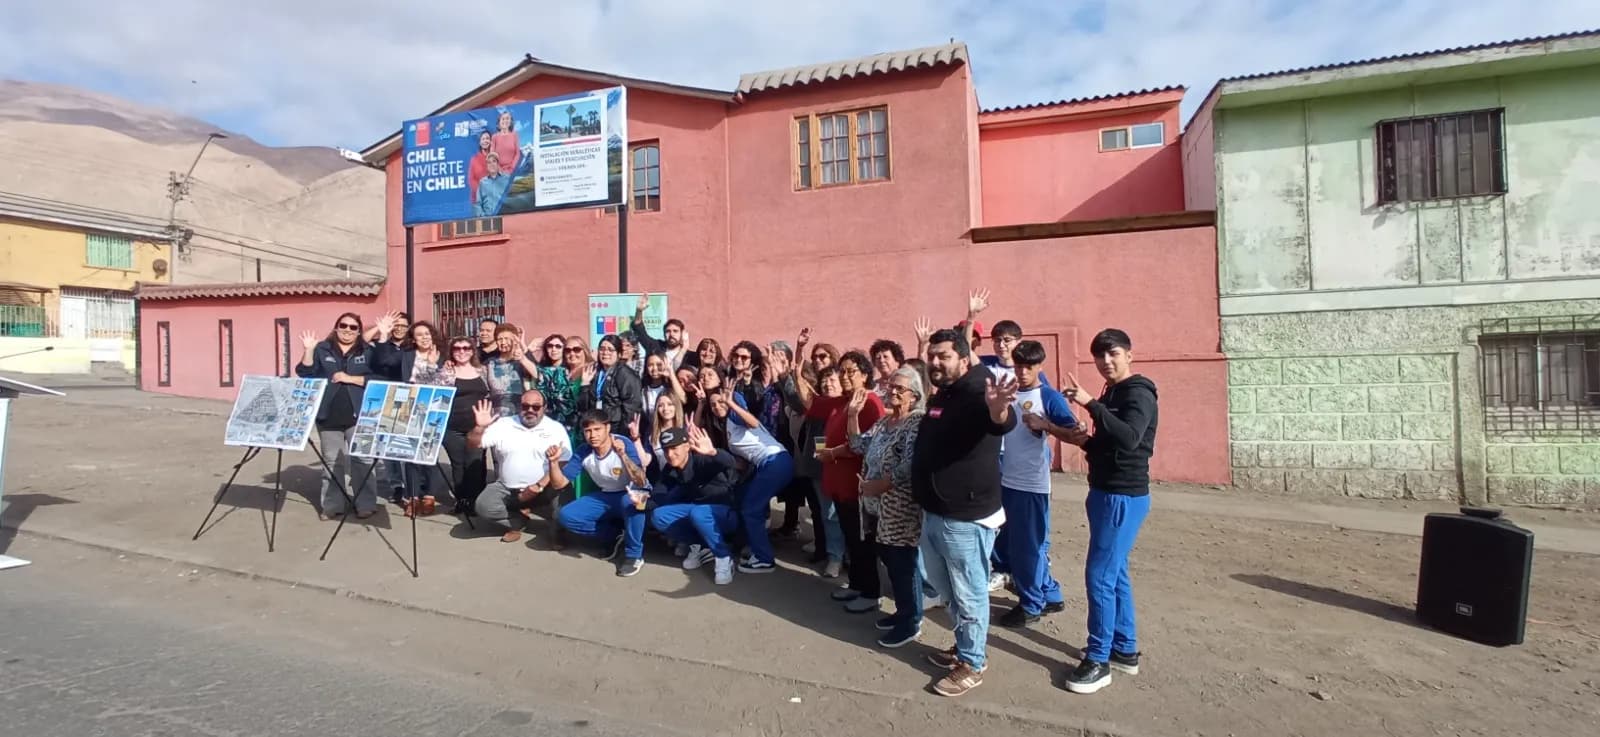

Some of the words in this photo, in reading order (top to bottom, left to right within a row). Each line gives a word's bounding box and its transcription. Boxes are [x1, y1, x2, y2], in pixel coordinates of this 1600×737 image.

[407, 147, 446, 164] CHILE
[407, 160, 464, 179] INVIERTE
[407, 180, 422, 194] EN
[425, 175, 466, 192] CHILE
